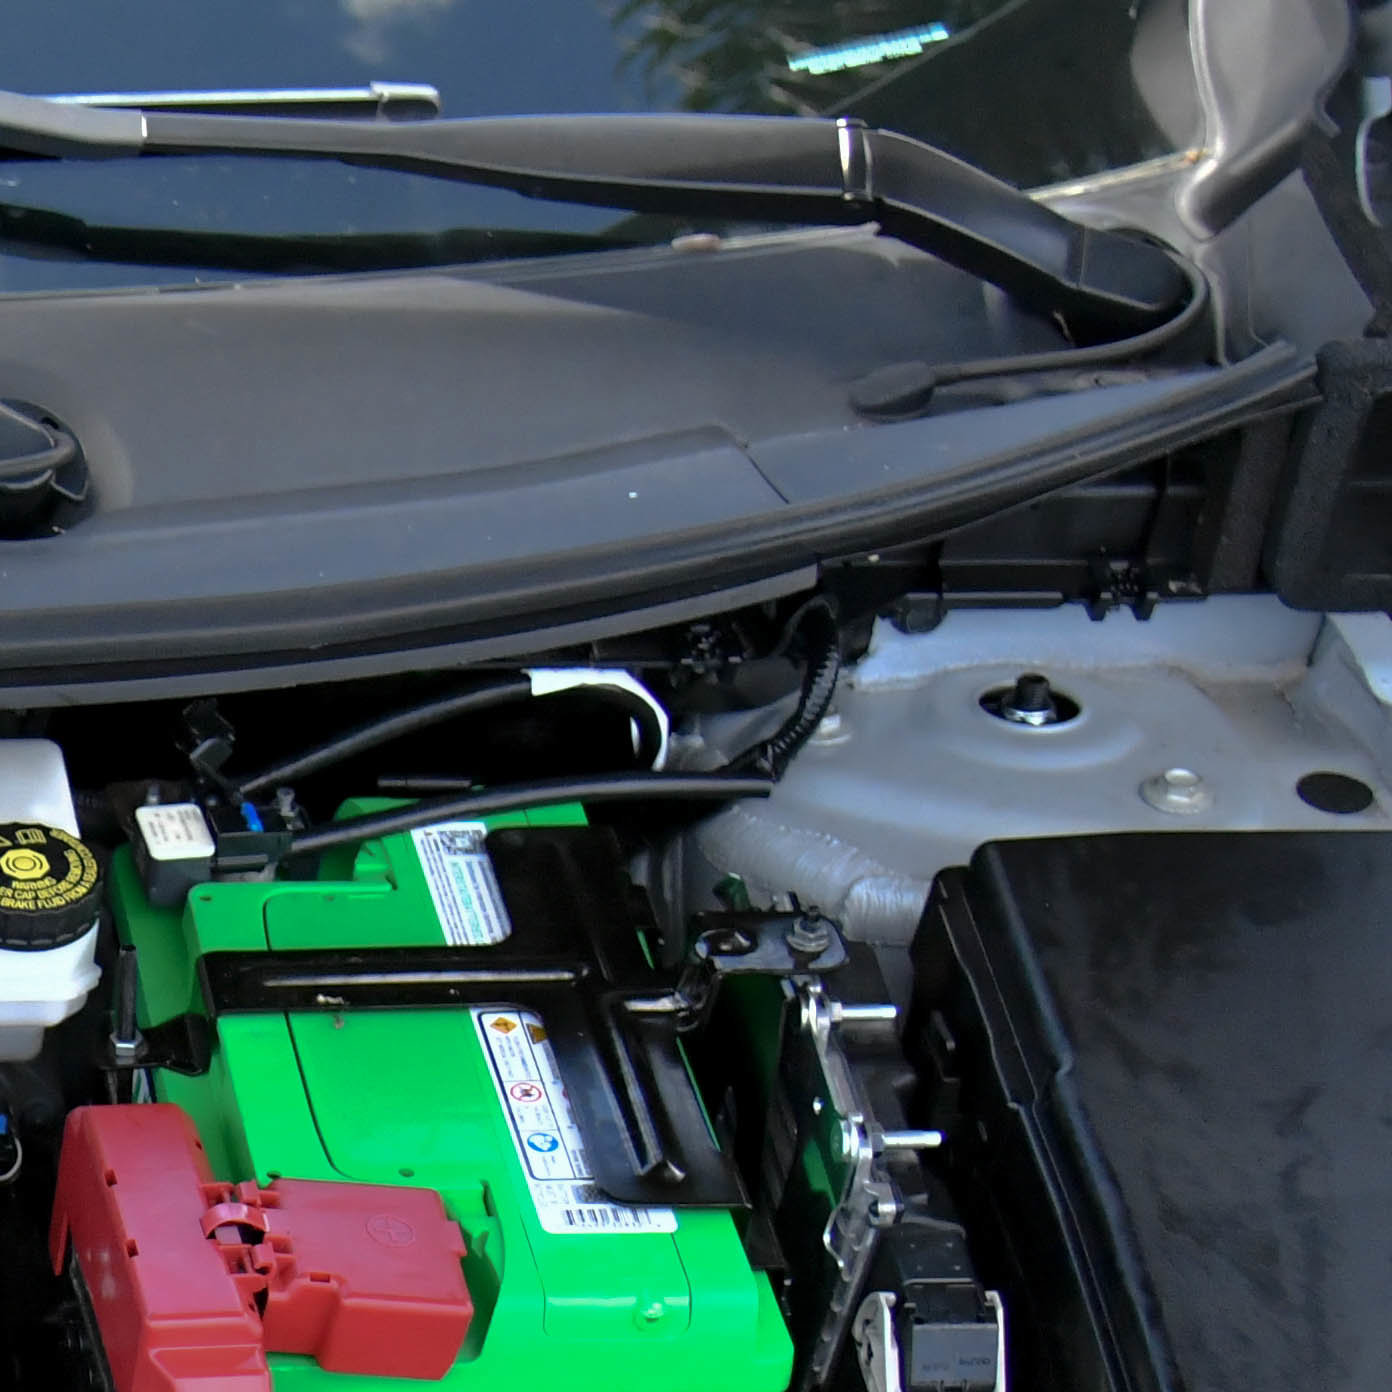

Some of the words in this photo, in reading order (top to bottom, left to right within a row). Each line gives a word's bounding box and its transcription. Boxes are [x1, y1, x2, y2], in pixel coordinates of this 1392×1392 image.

[15, 890, 36, 899] CAP
[1, 896, 36, 910] BRAKE
[37, 896, 66, 908] FLUID
